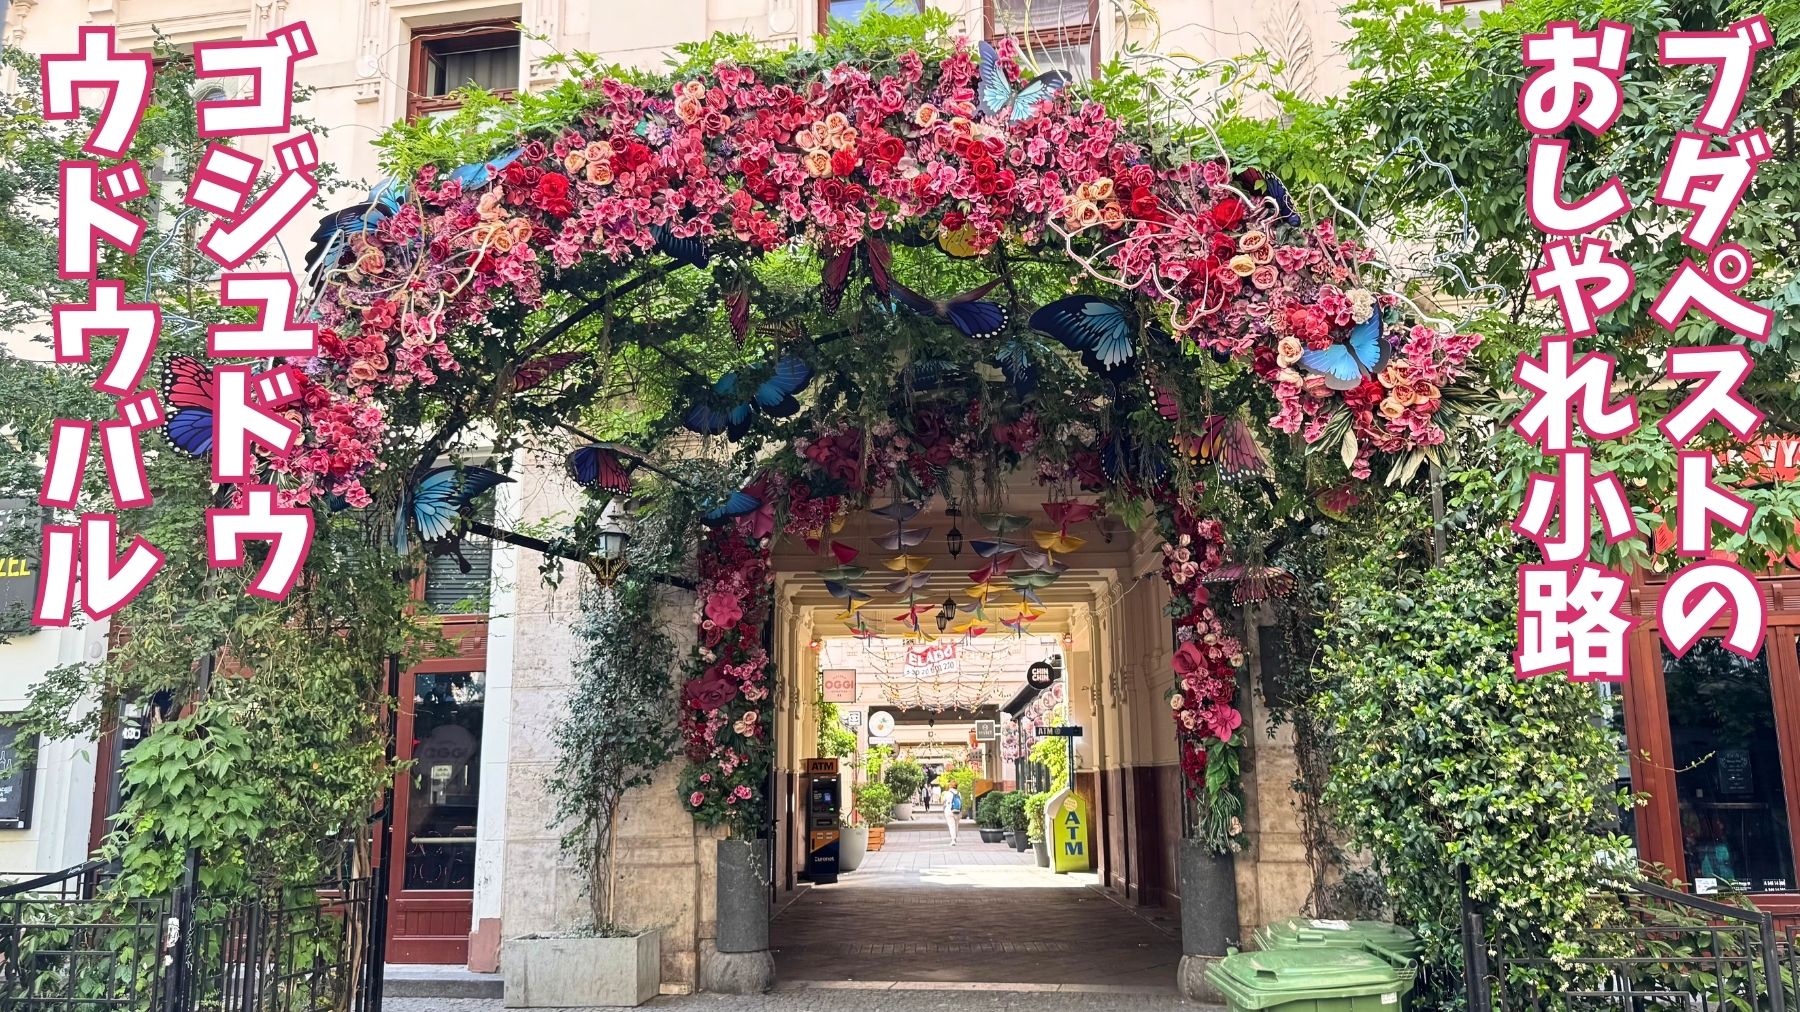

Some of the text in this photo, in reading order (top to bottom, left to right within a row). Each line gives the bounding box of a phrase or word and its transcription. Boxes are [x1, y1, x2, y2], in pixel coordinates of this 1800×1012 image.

[1031, 667, 1049, 675] CHIN
[1031, 674, 1050, 682] CHIN
[825, 680, 854, 689] OGGI
[1038, 727, 1054, 735] ATM
[811, 762, 834, 771] ATM
[1065, 811, 1083, 856] ATM
